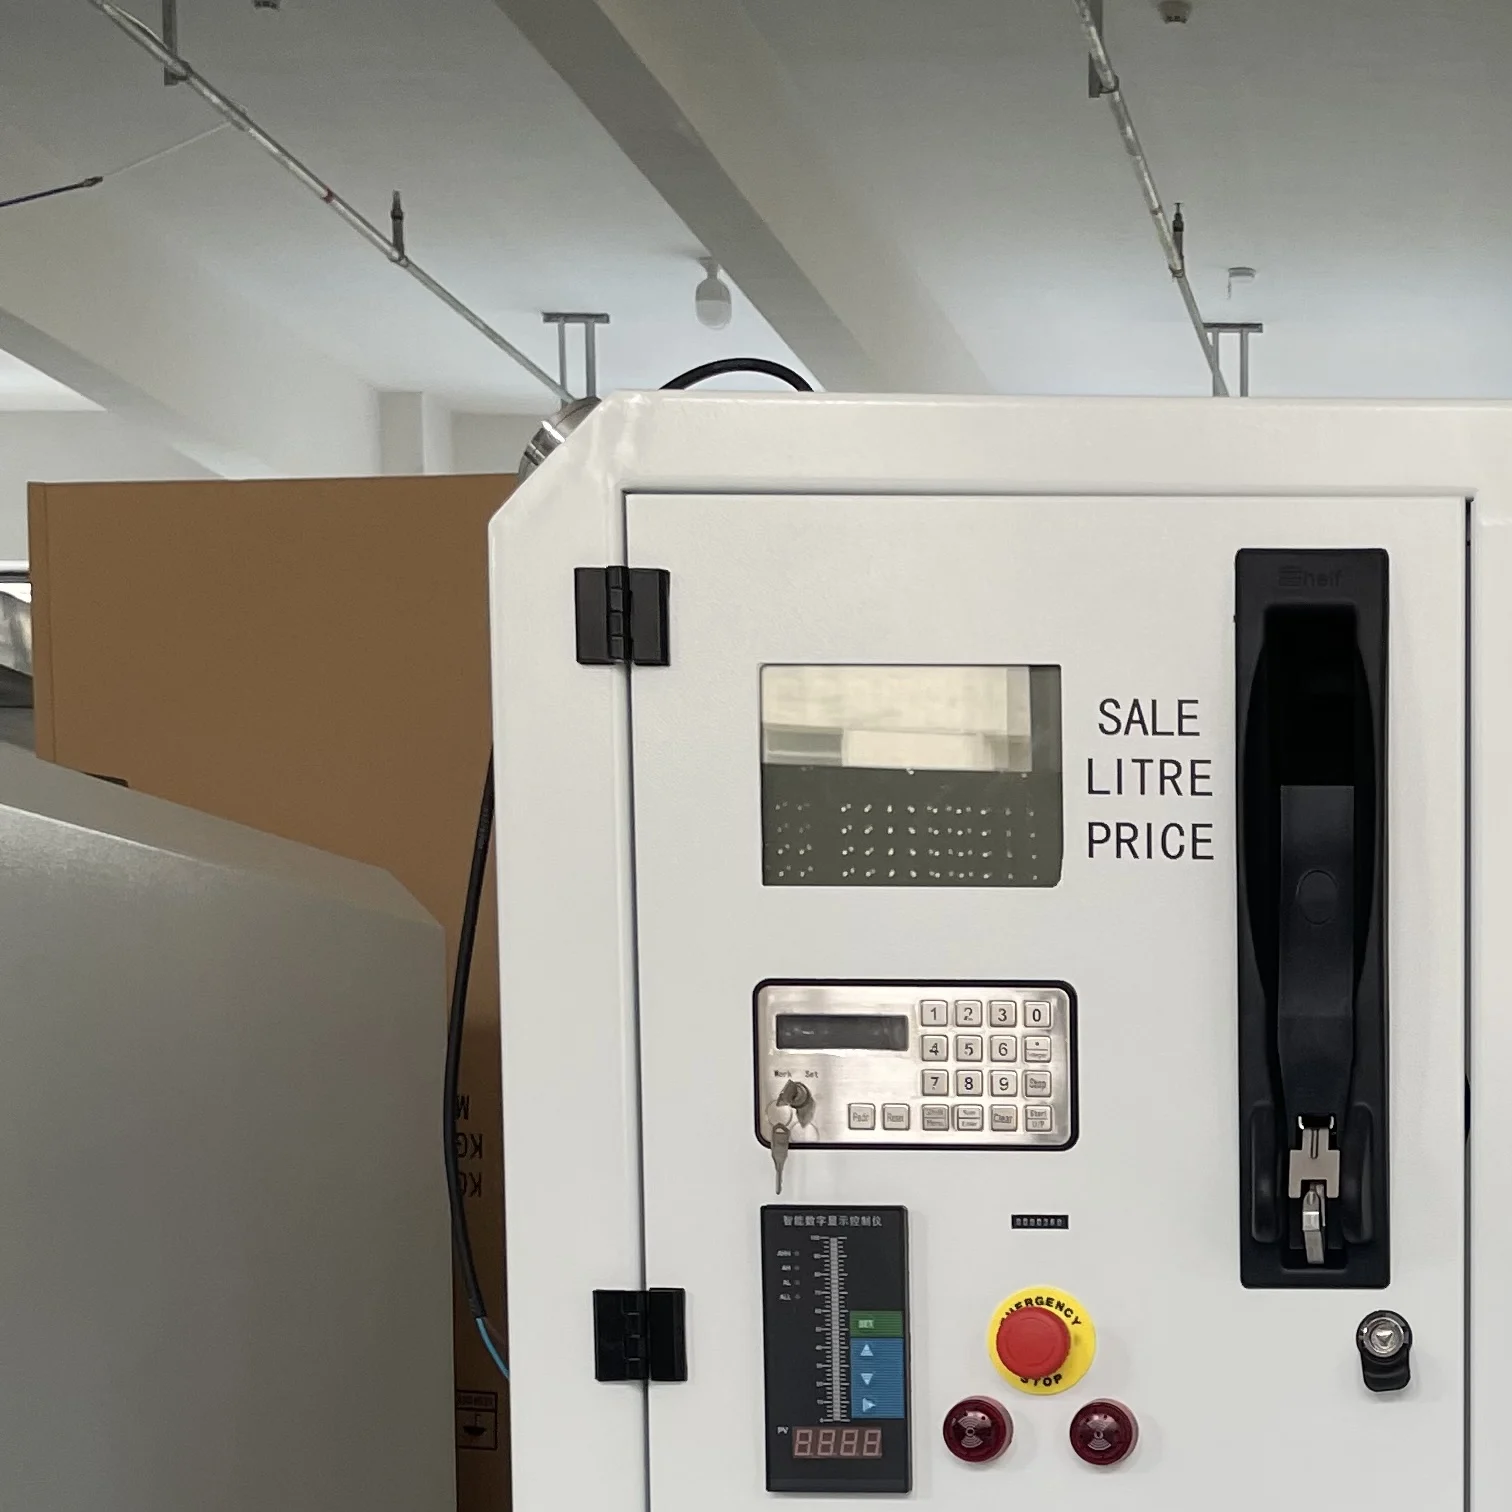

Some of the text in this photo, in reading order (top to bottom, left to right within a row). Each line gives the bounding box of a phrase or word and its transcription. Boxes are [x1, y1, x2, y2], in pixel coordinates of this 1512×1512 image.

[1098, 698, 1201, 737] SALE
[1087, 757, 1213, 797] LITRE
[1087, 821, 1214, 860] PRICE
[930, 1006, 1042, 1022] 1 2 3 0
[929, 1042, 1008, 1057] 4 5 6
[930, 1076, 940, 1090] 7
[964, 1076, 974, 1091] 8
[999, 1077, 1009, 1091] 9
